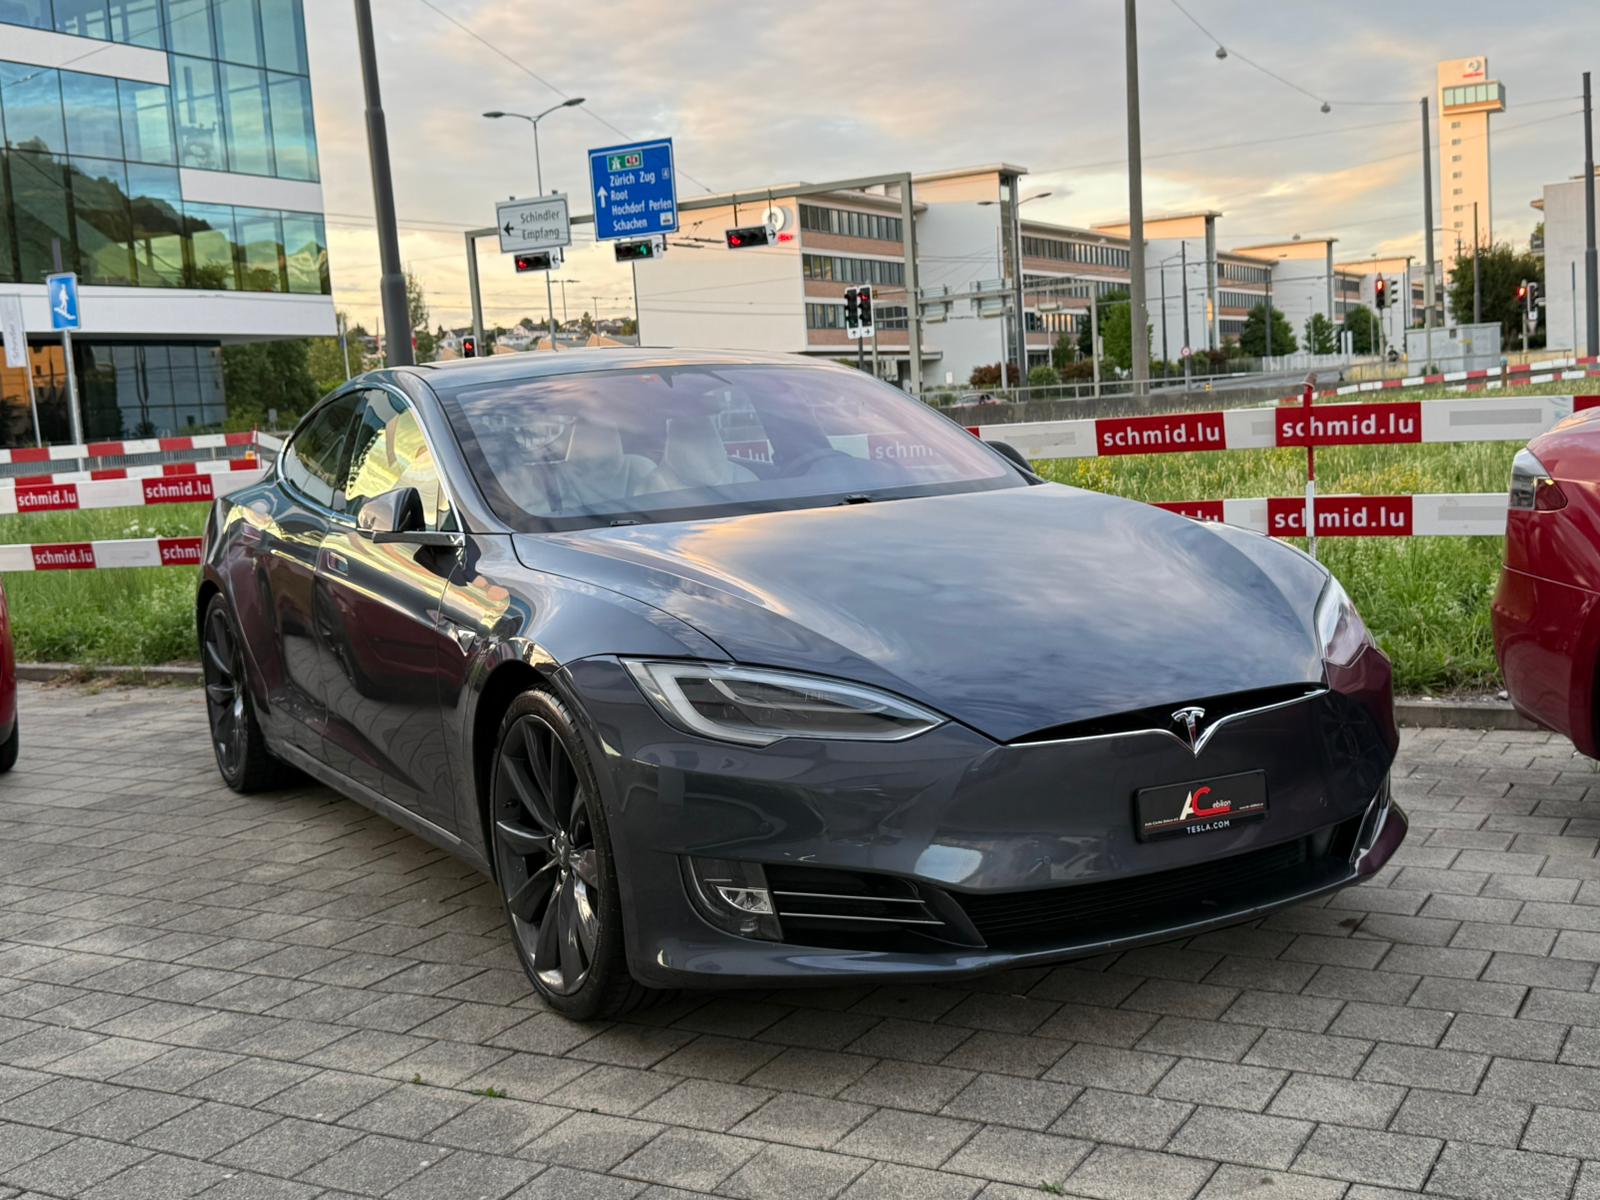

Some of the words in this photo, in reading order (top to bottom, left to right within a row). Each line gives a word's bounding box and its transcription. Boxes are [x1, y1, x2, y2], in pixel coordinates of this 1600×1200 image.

[610, 171, 635, 187] Zürich
[640, 171, 655, 184] Zug
[611, 189, 628, 201] Root
[612, 200, 645, 216] Hochdorf
[649, 198, 672, 211] Perlen
[520, 209, 560, 224] Schindler
[613, 217, 648, 231] Schachen
[522, 227, 560, 242] Empfang
[1282, 413, 1413, 437] schmid.lu
[1103, 422, 1219, 446] schmid.lu
[146, 481, 211, 499] schmid.lu
[18, 490, 77, 507] schmid.lu
[34, 550, 94, 565] schmid.lu
[1186, 820, 1230, 834] TESLA.COM
